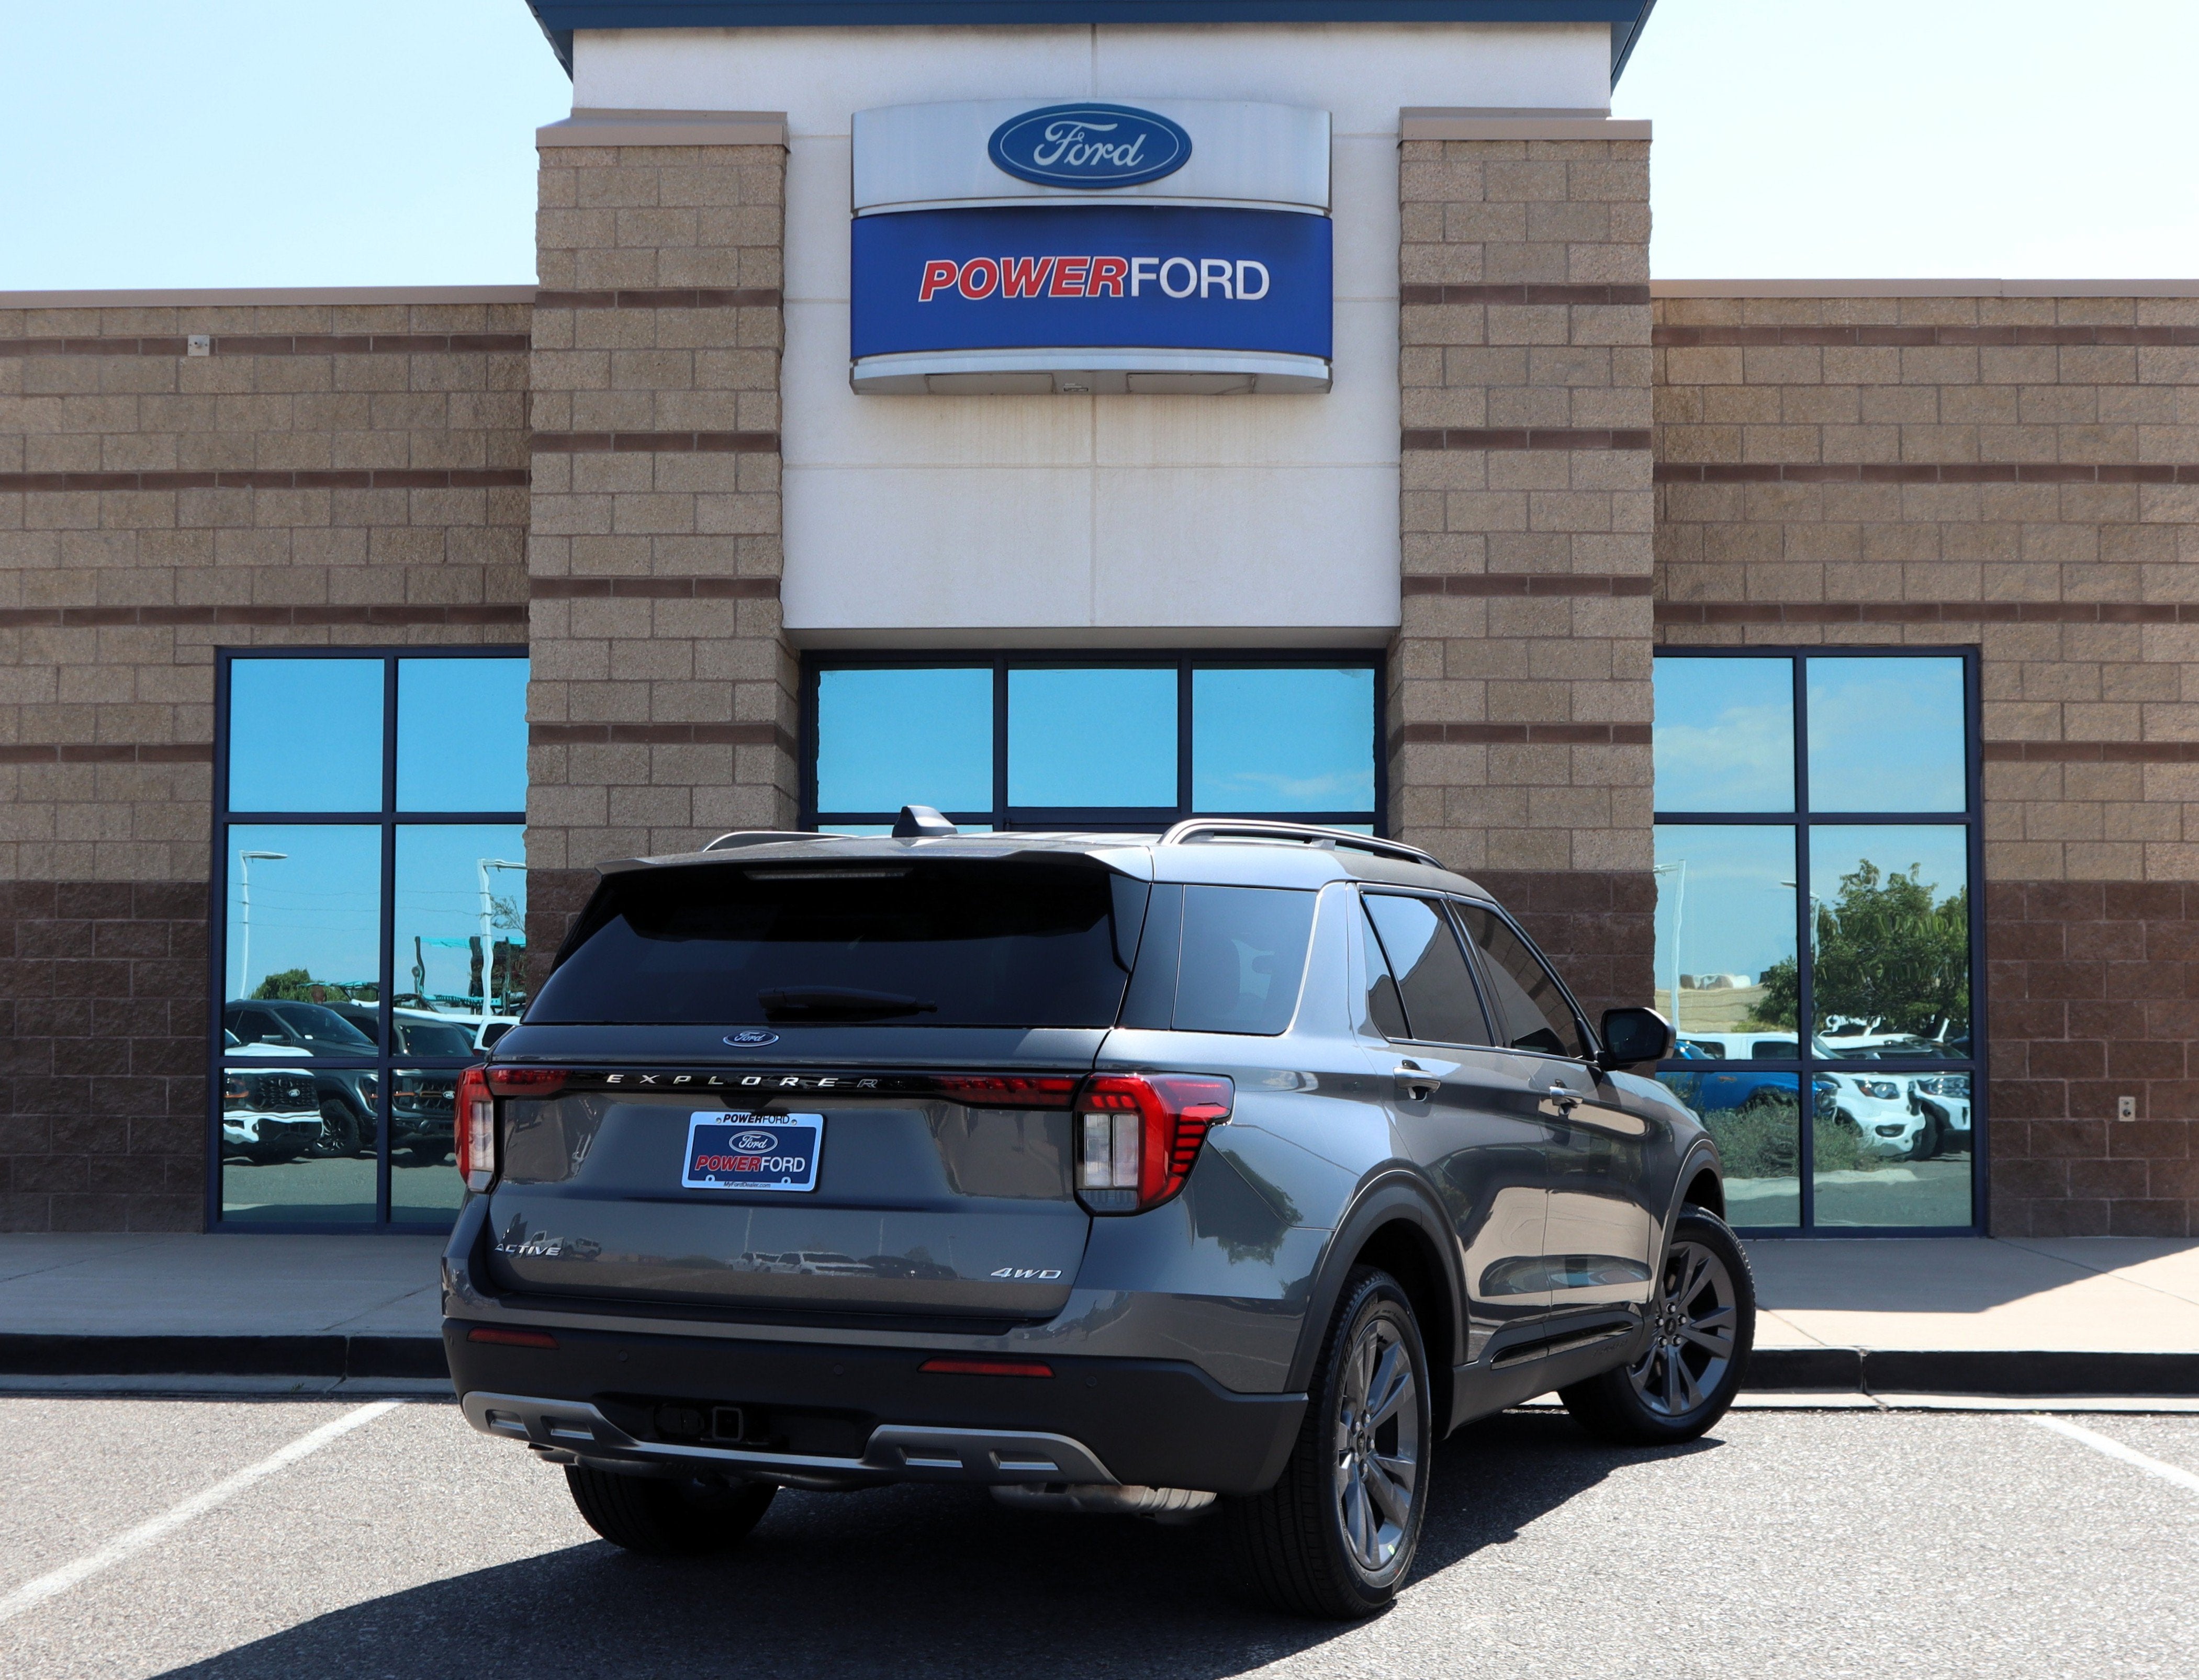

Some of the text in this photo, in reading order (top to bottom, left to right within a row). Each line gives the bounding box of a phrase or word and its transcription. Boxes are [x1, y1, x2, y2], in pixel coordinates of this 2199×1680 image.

[1034, 120, 1147, 166] Ford
[918, 256, 1270, 302] POWERFORD
[734, 1032, 766, 1041] Ford
[607, 1074, 878, 1088] EXPLORER
[723, 1113, 790, 1124] POWERFORD
[738, 1135, 768, 1149] Ford
[694, 1155, 805, 1172] POWERFORD
[495, 1244, 562, 1256] ACTIVE
[991, 1267, 1062, 1279] 4WD
